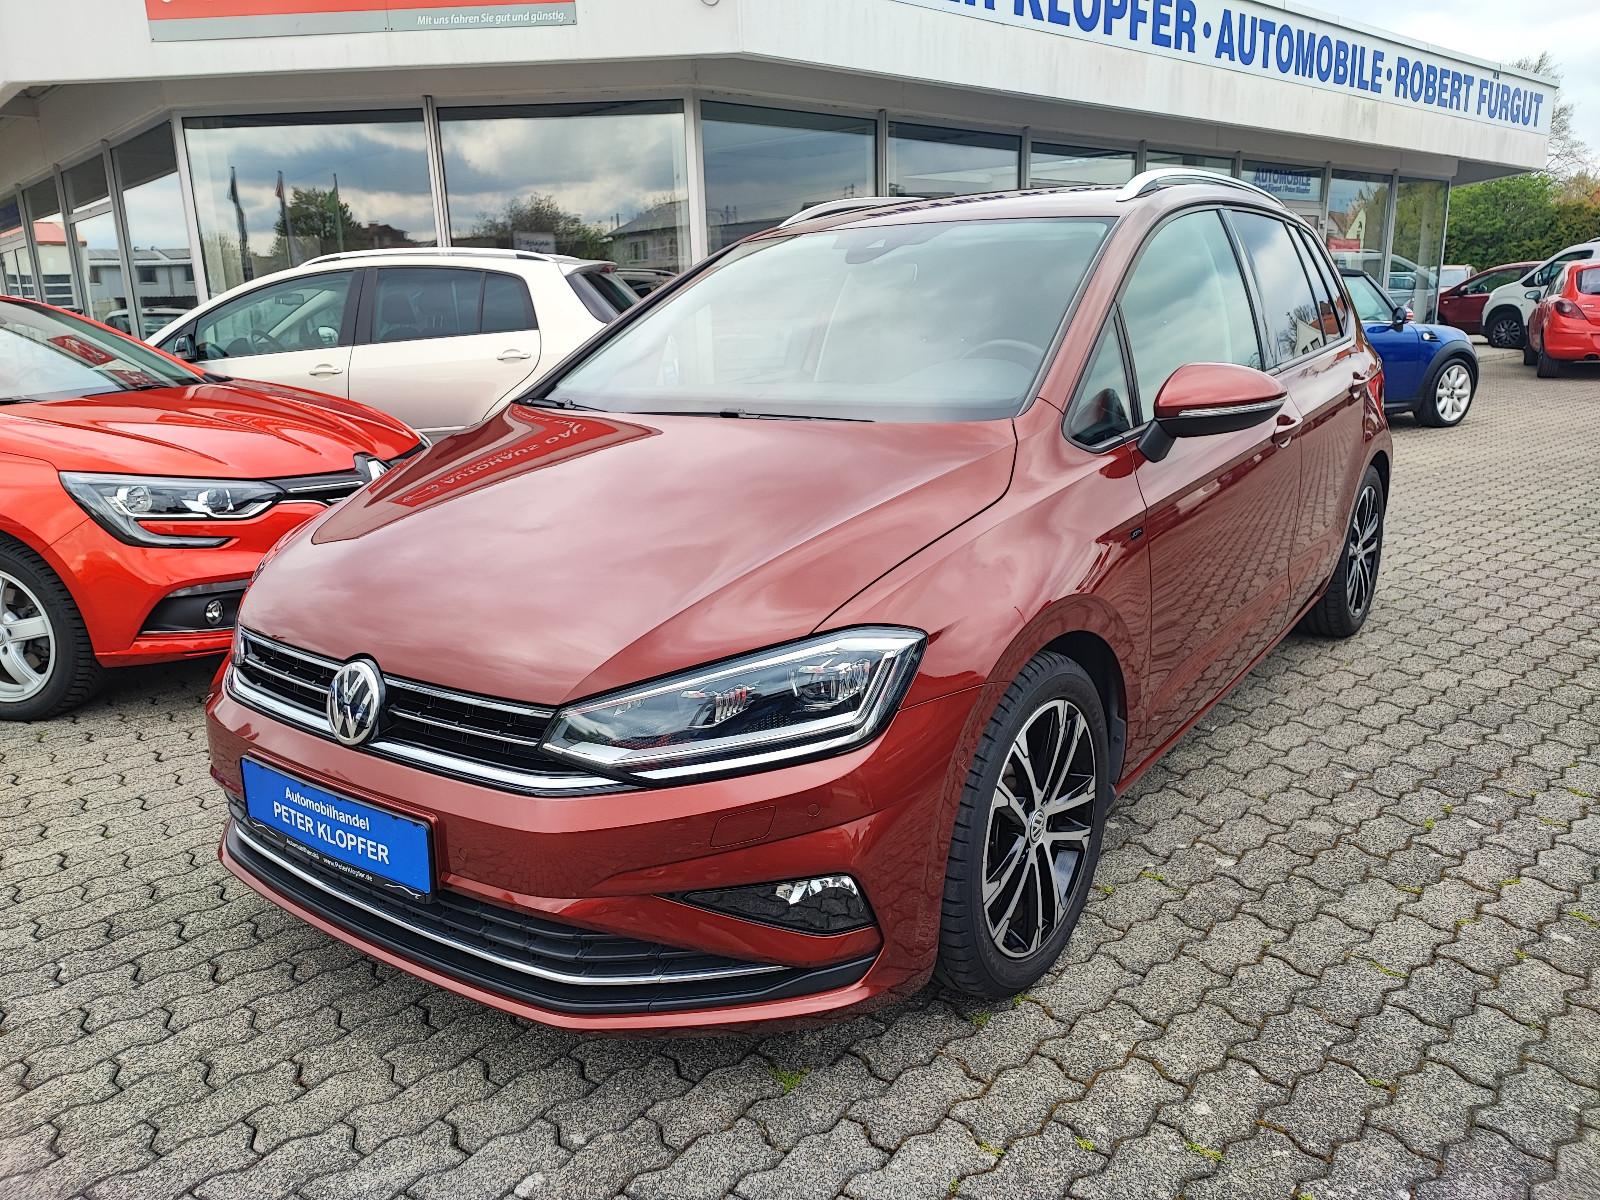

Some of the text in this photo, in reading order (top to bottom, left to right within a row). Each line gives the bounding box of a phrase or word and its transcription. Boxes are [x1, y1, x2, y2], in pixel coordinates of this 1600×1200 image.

[417, 10, 567, 25] Mit uns fahren Sie gut und günstig.
[1214, 9, 1385, 94] AUTOMOBILE
[1394, 56, 1474, 113] ROBERT
[1477, 72, 1544, 128] FÜRGUT
[1255, 168, 1311, 187] AUTOMOBILE
[285, 786, 370, 832] Automobilhandel
[273, 800, 390, 865] PETER KLOPFER
